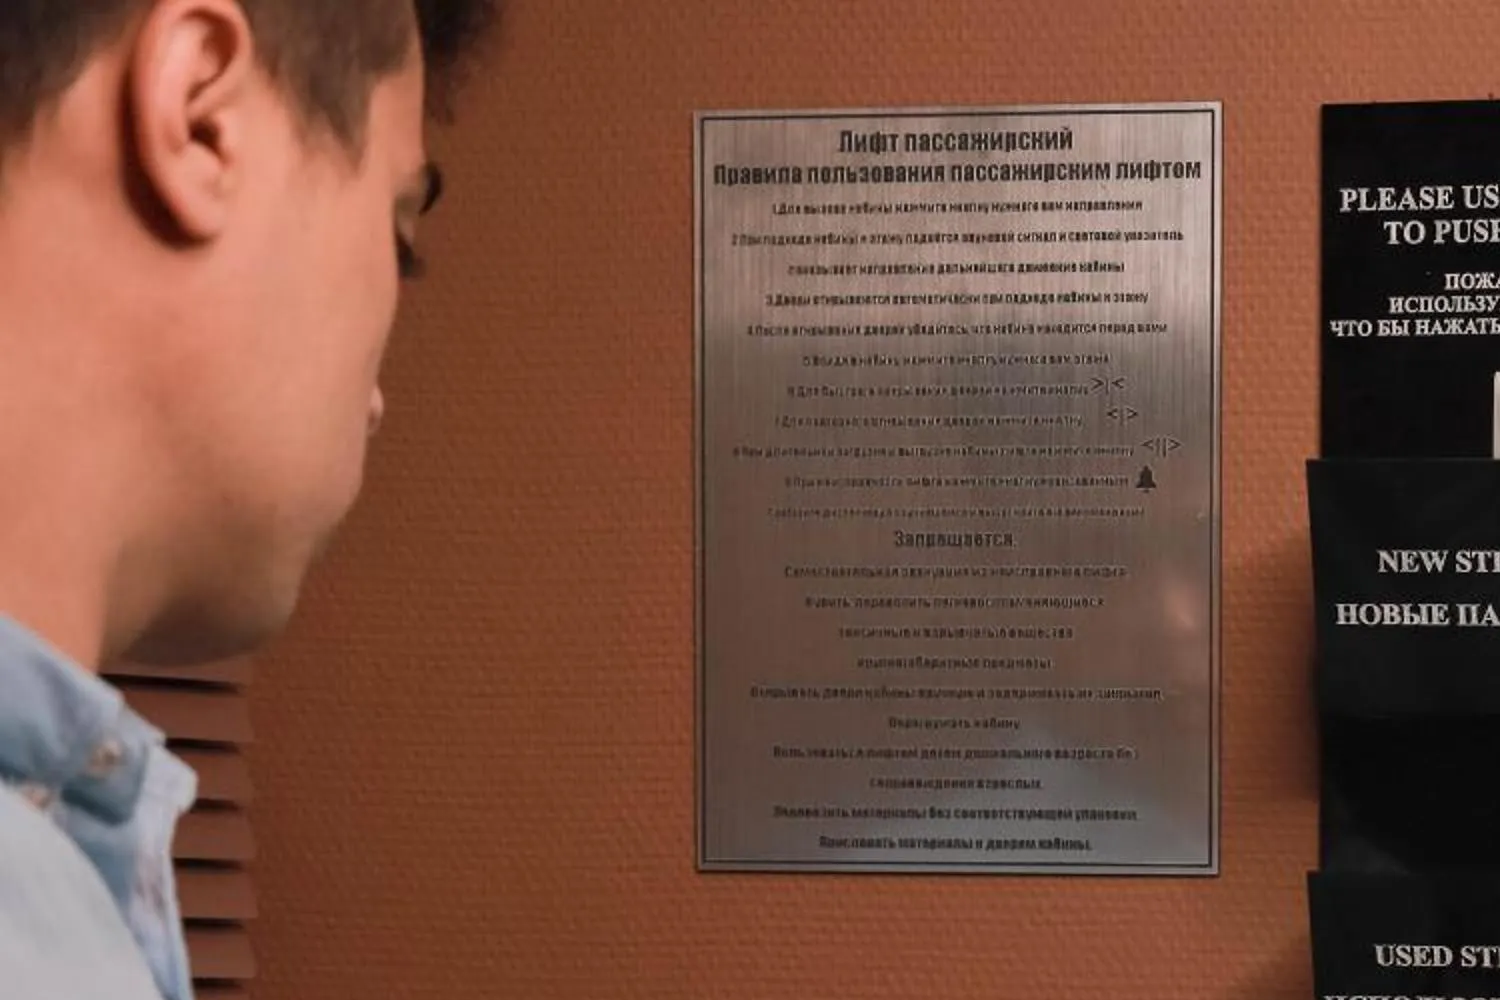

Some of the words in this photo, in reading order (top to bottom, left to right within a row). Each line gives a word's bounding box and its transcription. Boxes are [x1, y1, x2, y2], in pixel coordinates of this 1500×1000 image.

[840, 130, 899, 154] Лифт
[905, 127, 1073, 152] пассажирский
[713, 164, 802, 185] Правила
[807, 164, 945, 184] пользования
[951, 162, 1111, 182] пассажирским
[1115, 159, 1201, 181] лифтом
[1340, 186, 1454, 212] PLEASE
[1384, 220, 1426, 244] TO
[1330, 320, 1372, 336] ЧТО
[1377, 320, 1410, 336] БЫ
[1378, 550, 1448, 572] NEW
[1336, 604, 1450, 625] НОВЫЕ
[1375, 944, 1452, 966] USED
